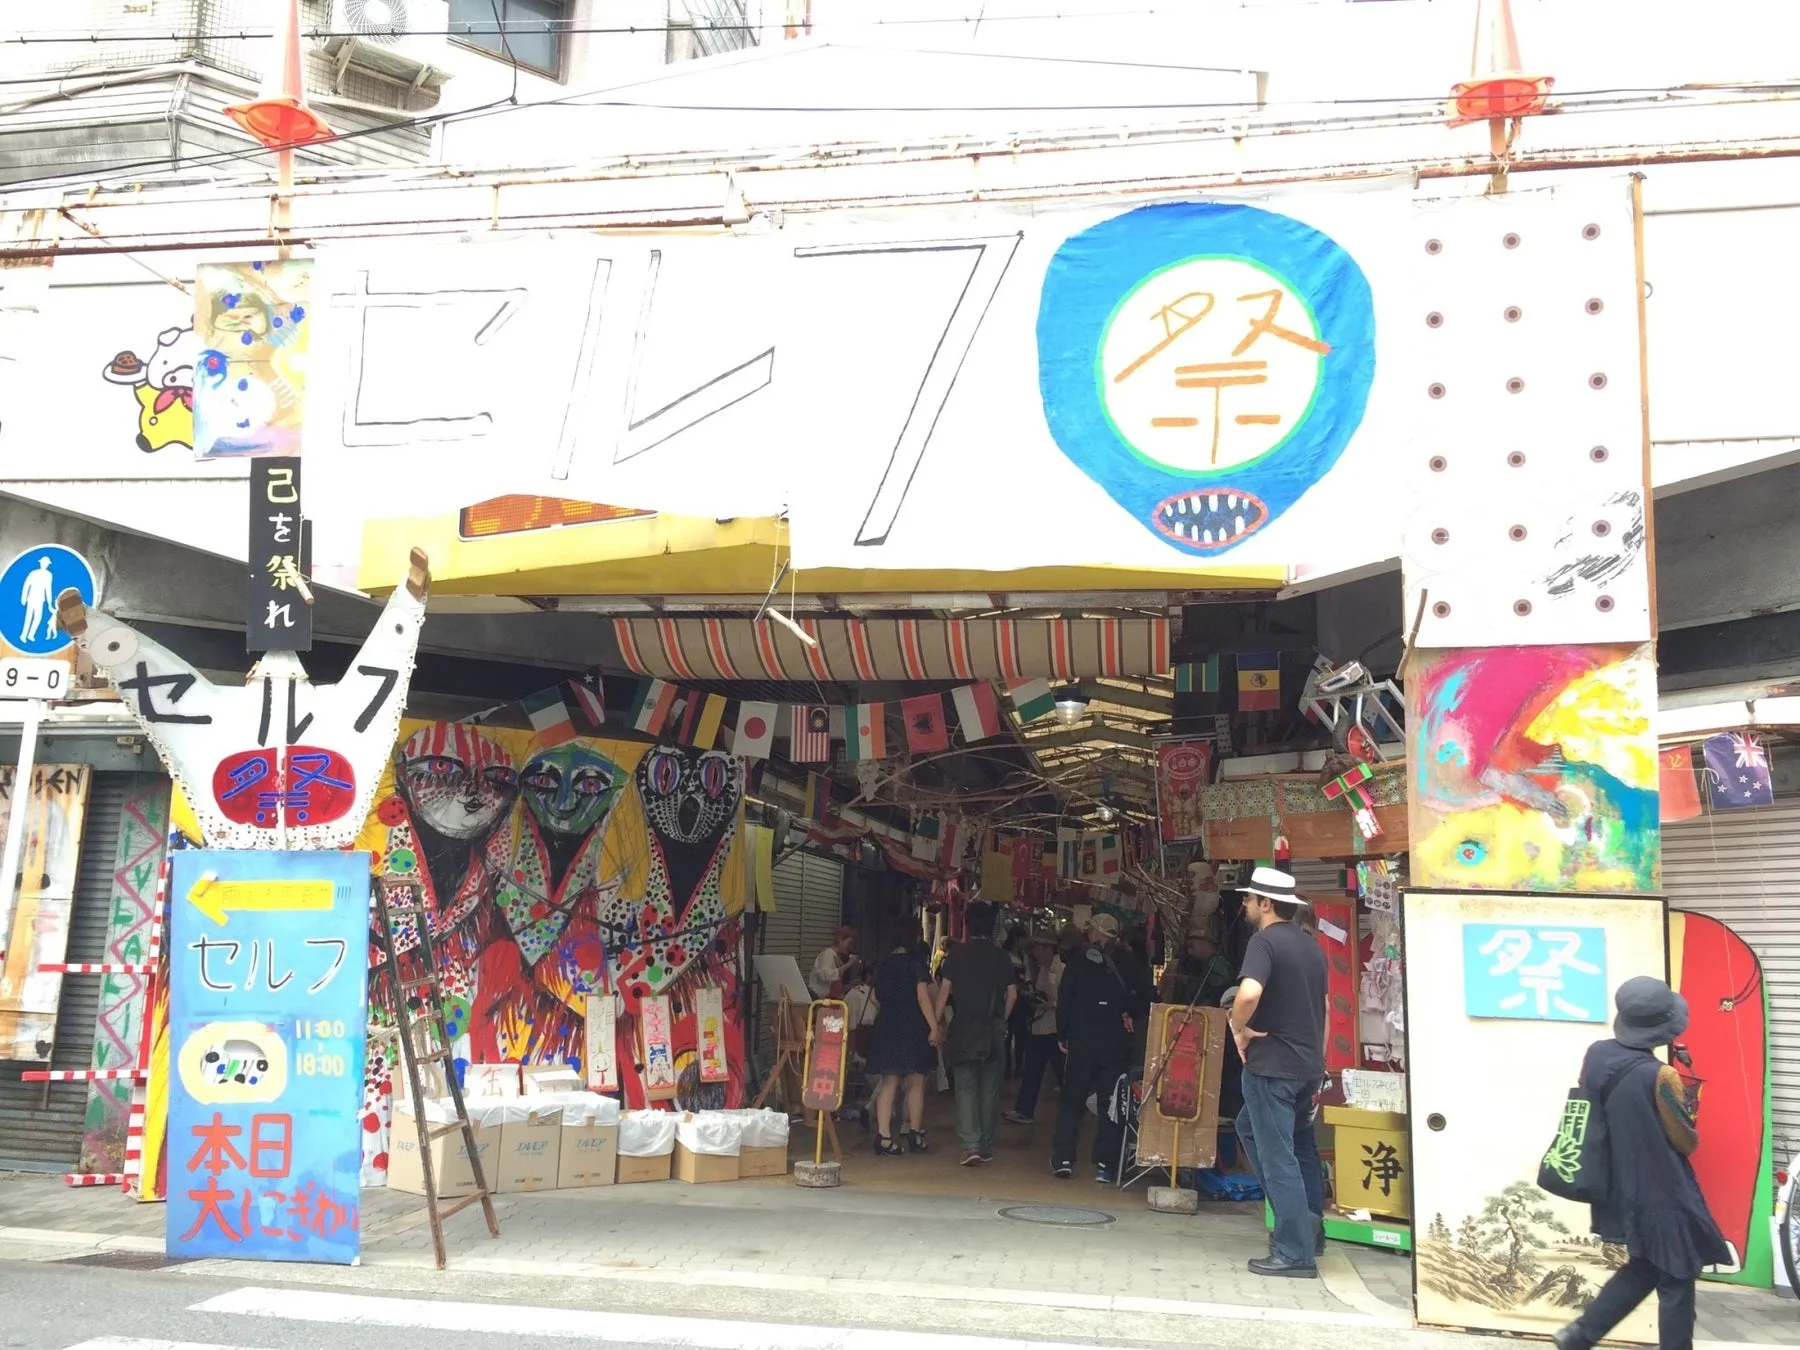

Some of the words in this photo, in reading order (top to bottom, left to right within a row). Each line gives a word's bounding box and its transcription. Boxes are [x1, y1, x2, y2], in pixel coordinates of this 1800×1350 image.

[264, 468, 299, 629] 己を祭れ
[119, 661, 399, 747] セルフ
[187, 934, 349, 995] セルフ
[1478, 930, 1600, 1019] 祭
[295, 1019, 345, 1040] 11:00
[296, 1052, 345, 1077] 18:00
[187, 1112, 292, 1178] 本日
[180, 1176, 360, 1244] 大にぎわい
